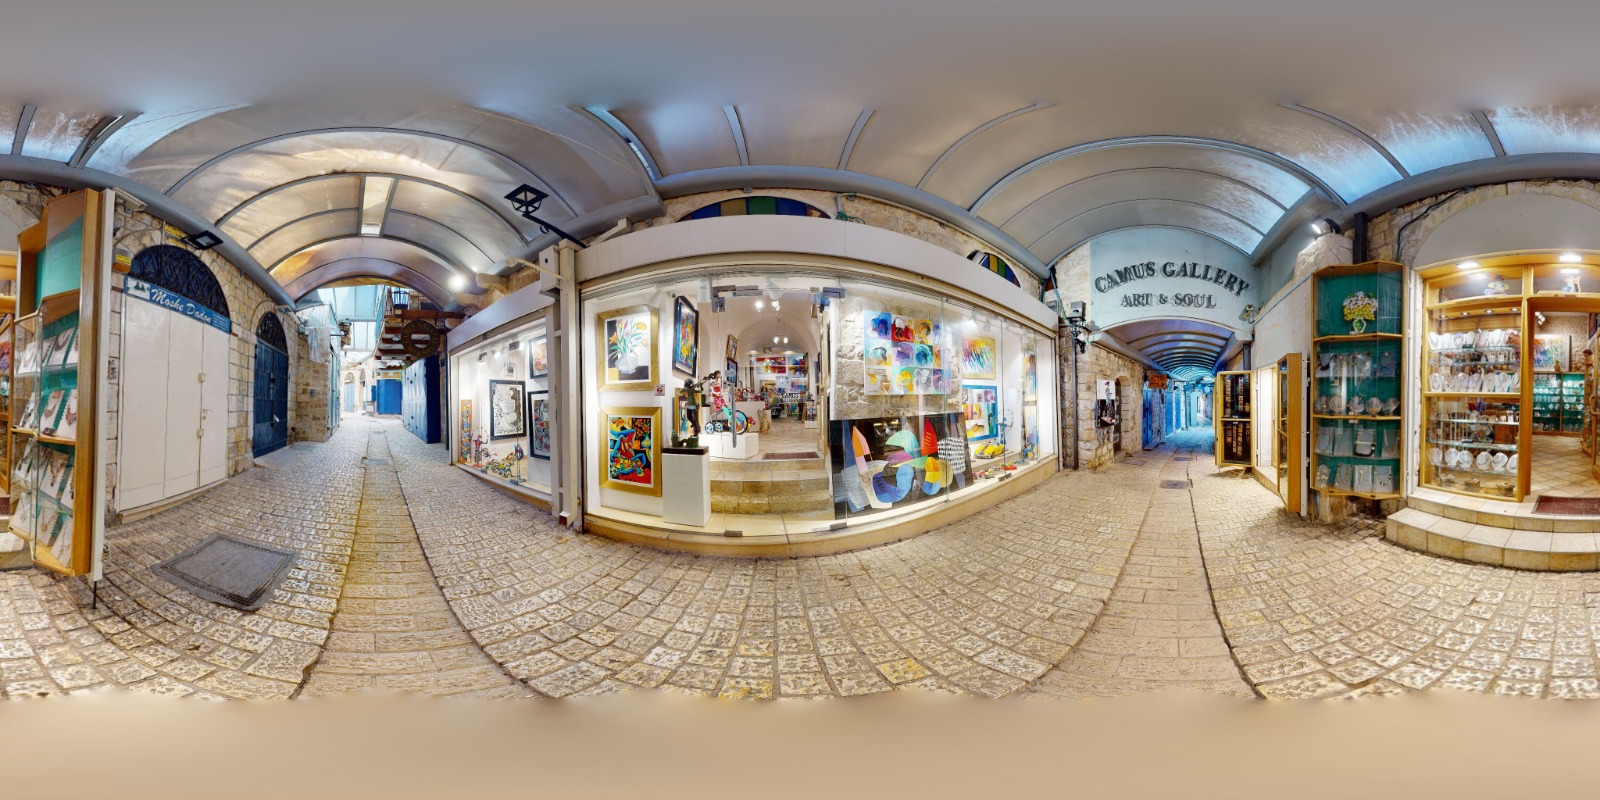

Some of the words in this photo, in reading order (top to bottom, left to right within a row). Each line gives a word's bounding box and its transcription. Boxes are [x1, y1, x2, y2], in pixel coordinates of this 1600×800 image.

[1095, 261, 1156, 293] CAMUS
[1162, 261, 1250, 297] GALLERY
[151, 288, 184, 312] Moshe
[186, 303, 212, 323] Dadon
[1120, 293, 1153, 308] ART
[1159, 294, 1169, 304] &
[1174, 293, 1217, 308] SOUL
